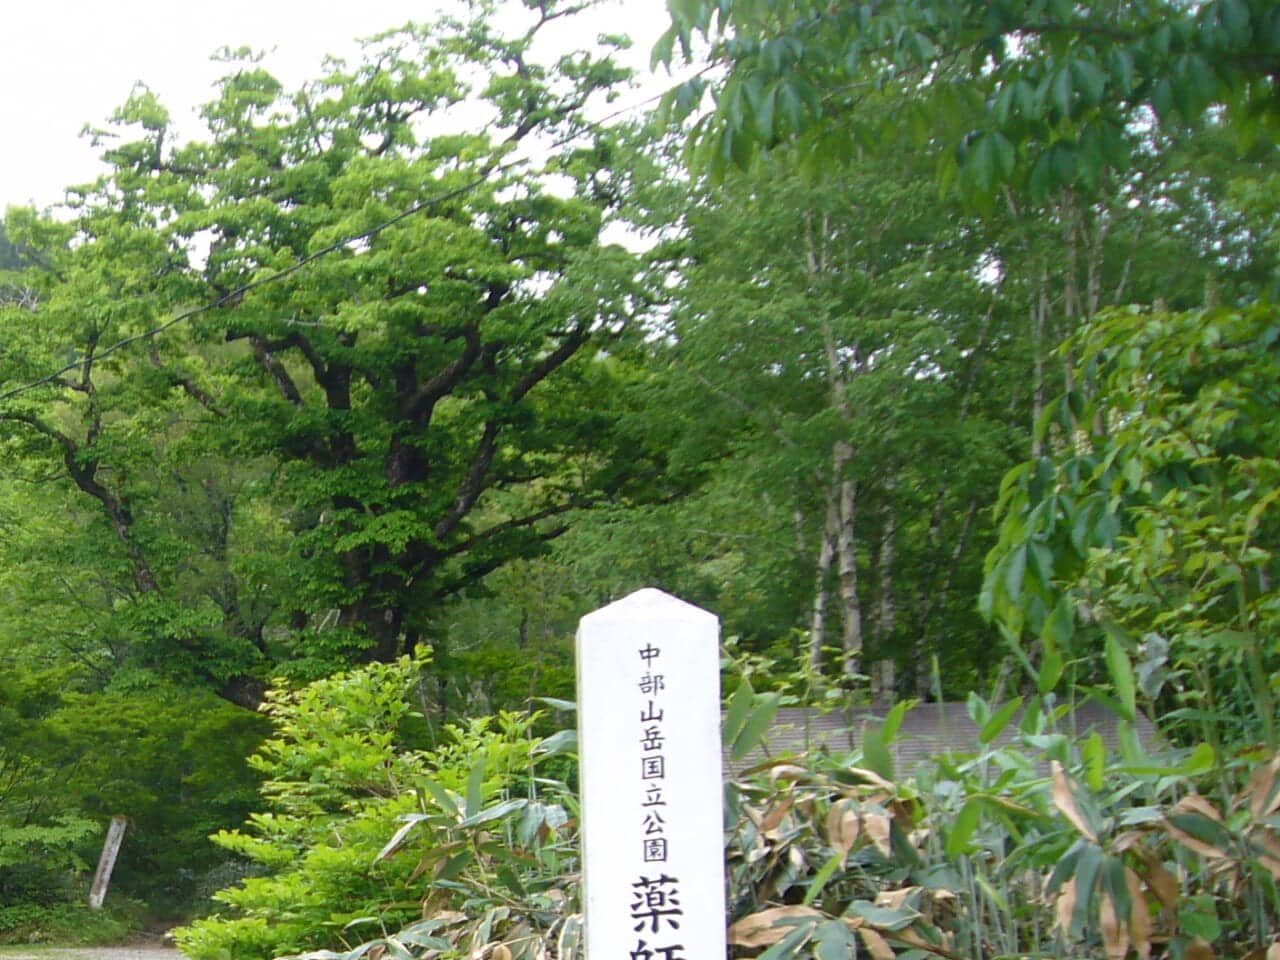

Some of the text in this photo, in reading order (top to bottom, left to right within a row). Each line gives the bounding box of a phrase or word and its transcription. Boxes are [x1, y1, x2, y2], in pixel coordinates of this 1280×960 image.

[637, 643, 668, 863] 中部山岳国立公園
